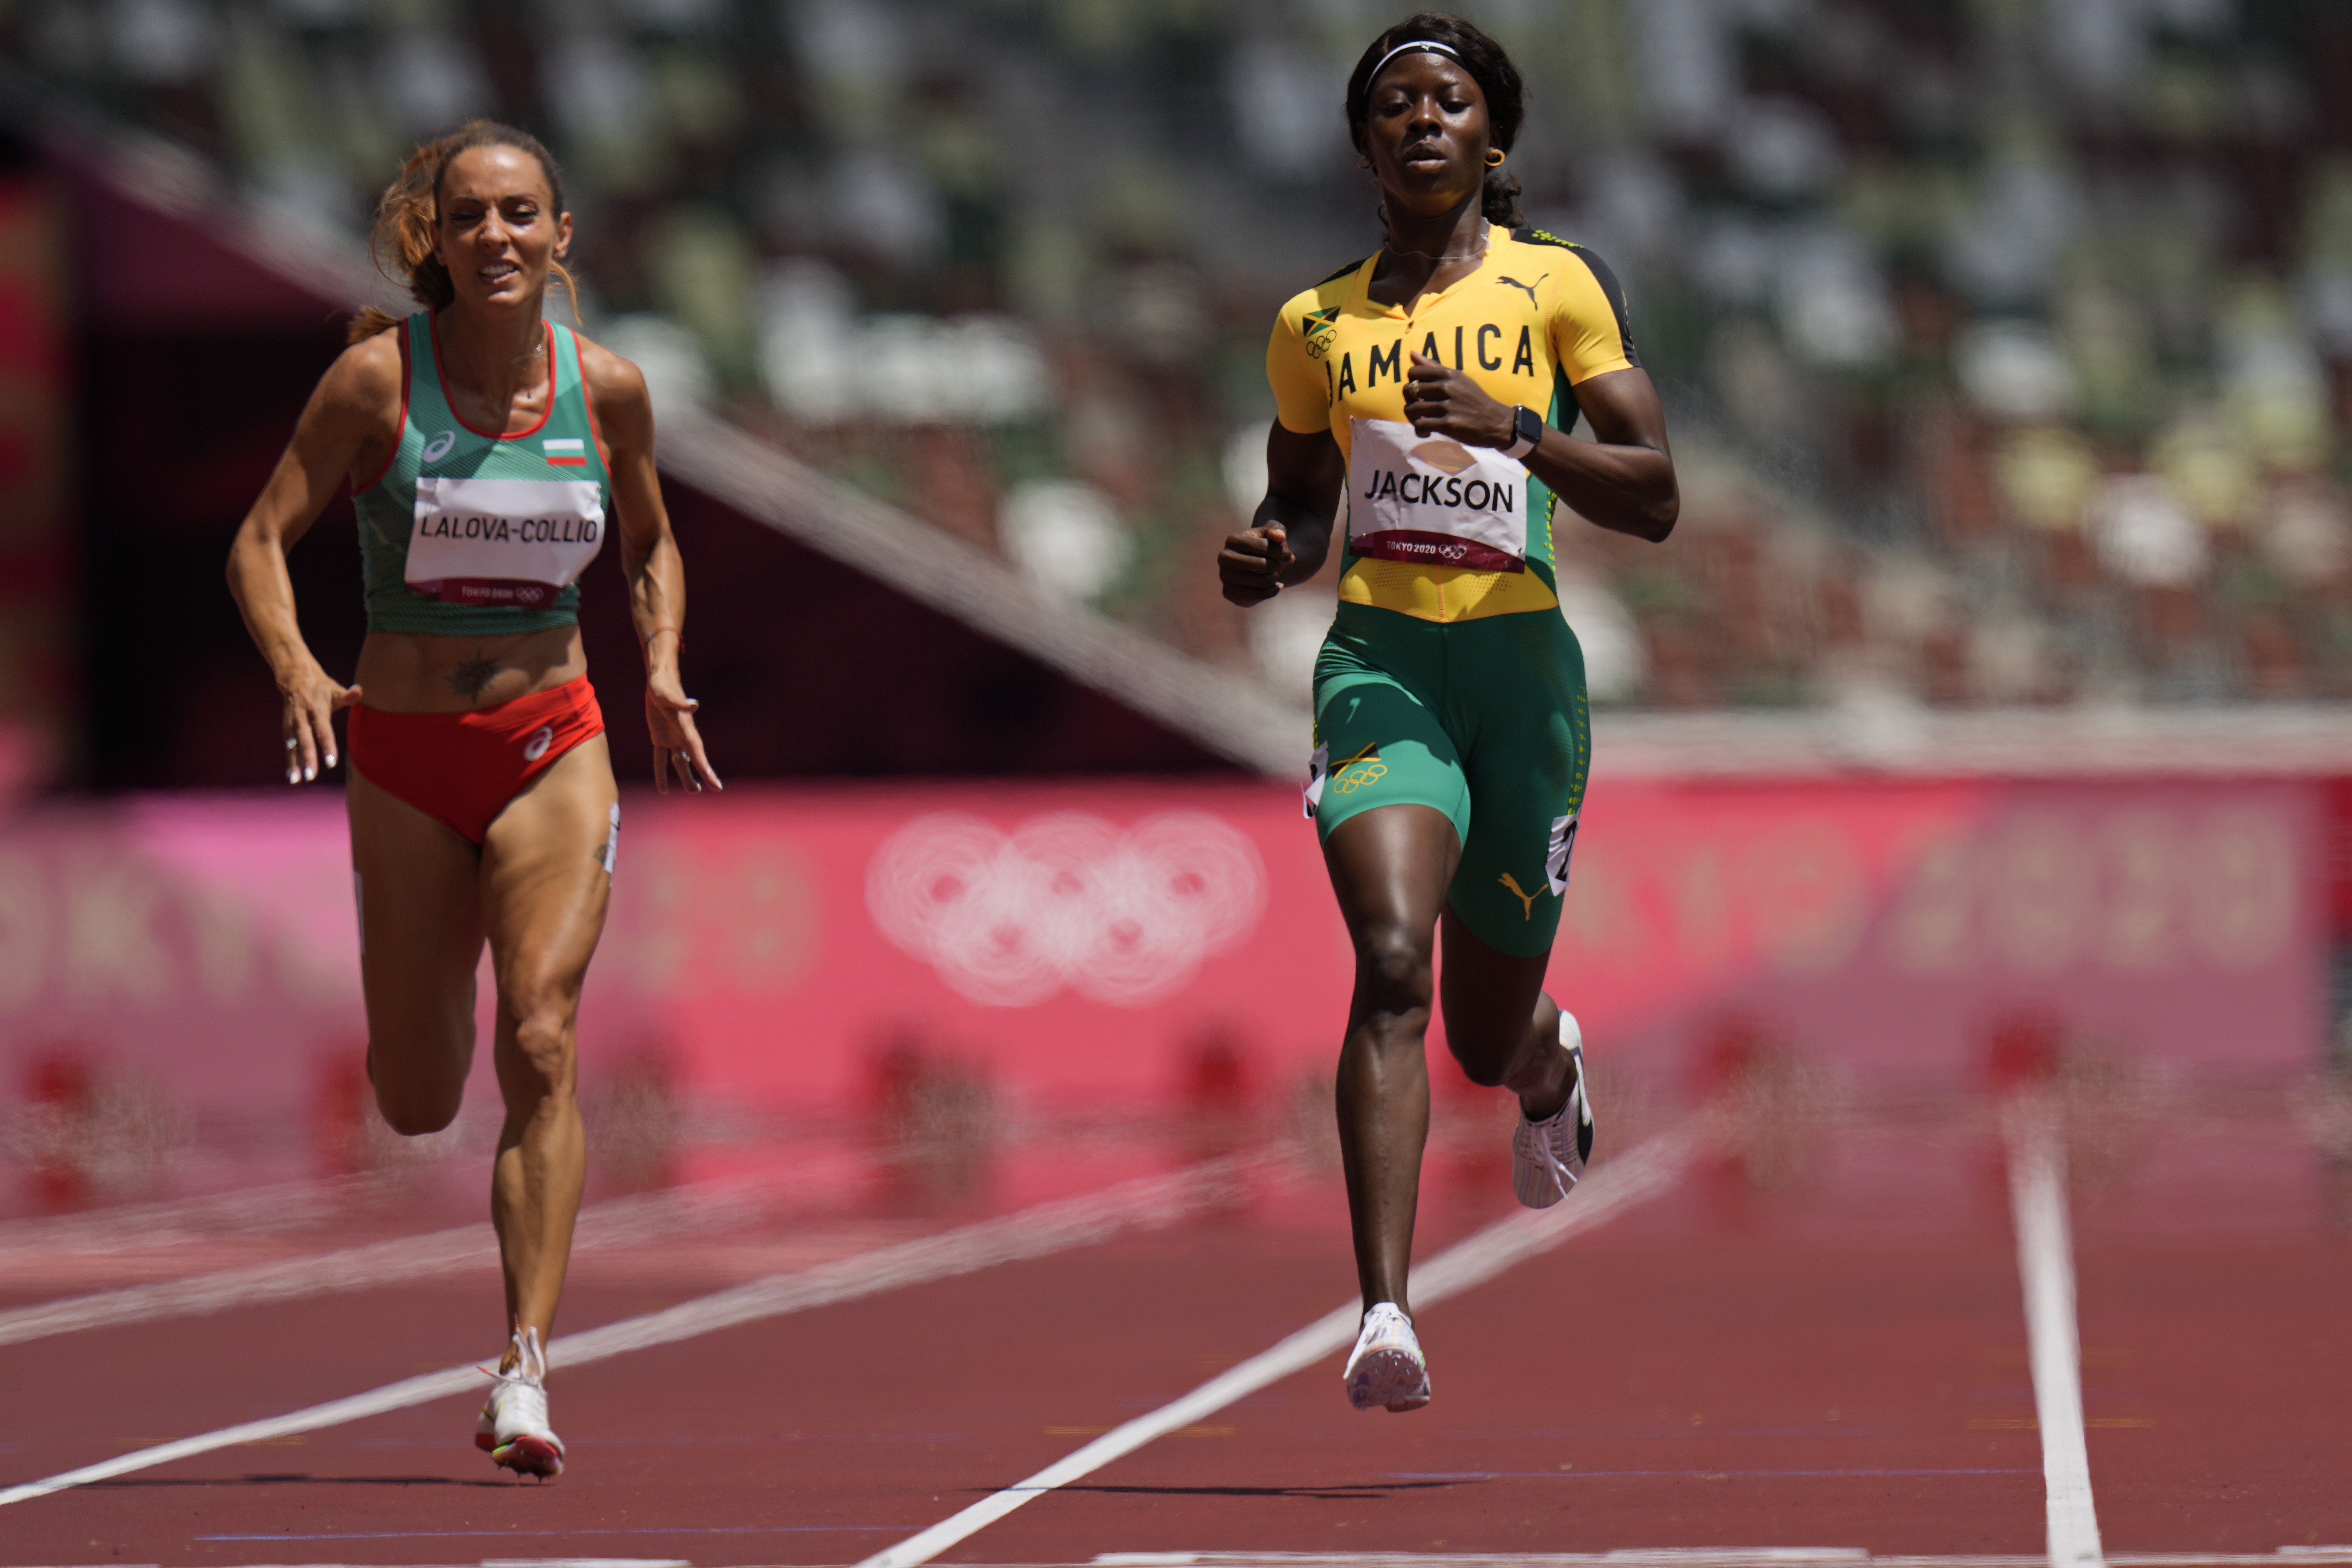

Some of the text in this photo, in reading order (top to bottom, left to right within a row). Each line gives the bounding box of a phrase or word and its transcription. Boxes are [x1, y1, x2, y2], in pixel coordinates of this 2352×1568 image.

[1325, 323, 1534, 408] JAMAICA
[1365, 470, 1513, 513] JACKSON
[420, 516, 597, 543] LALOVA-COLLIO
[1386, 541, 1436, 554] TOKYO 2020
